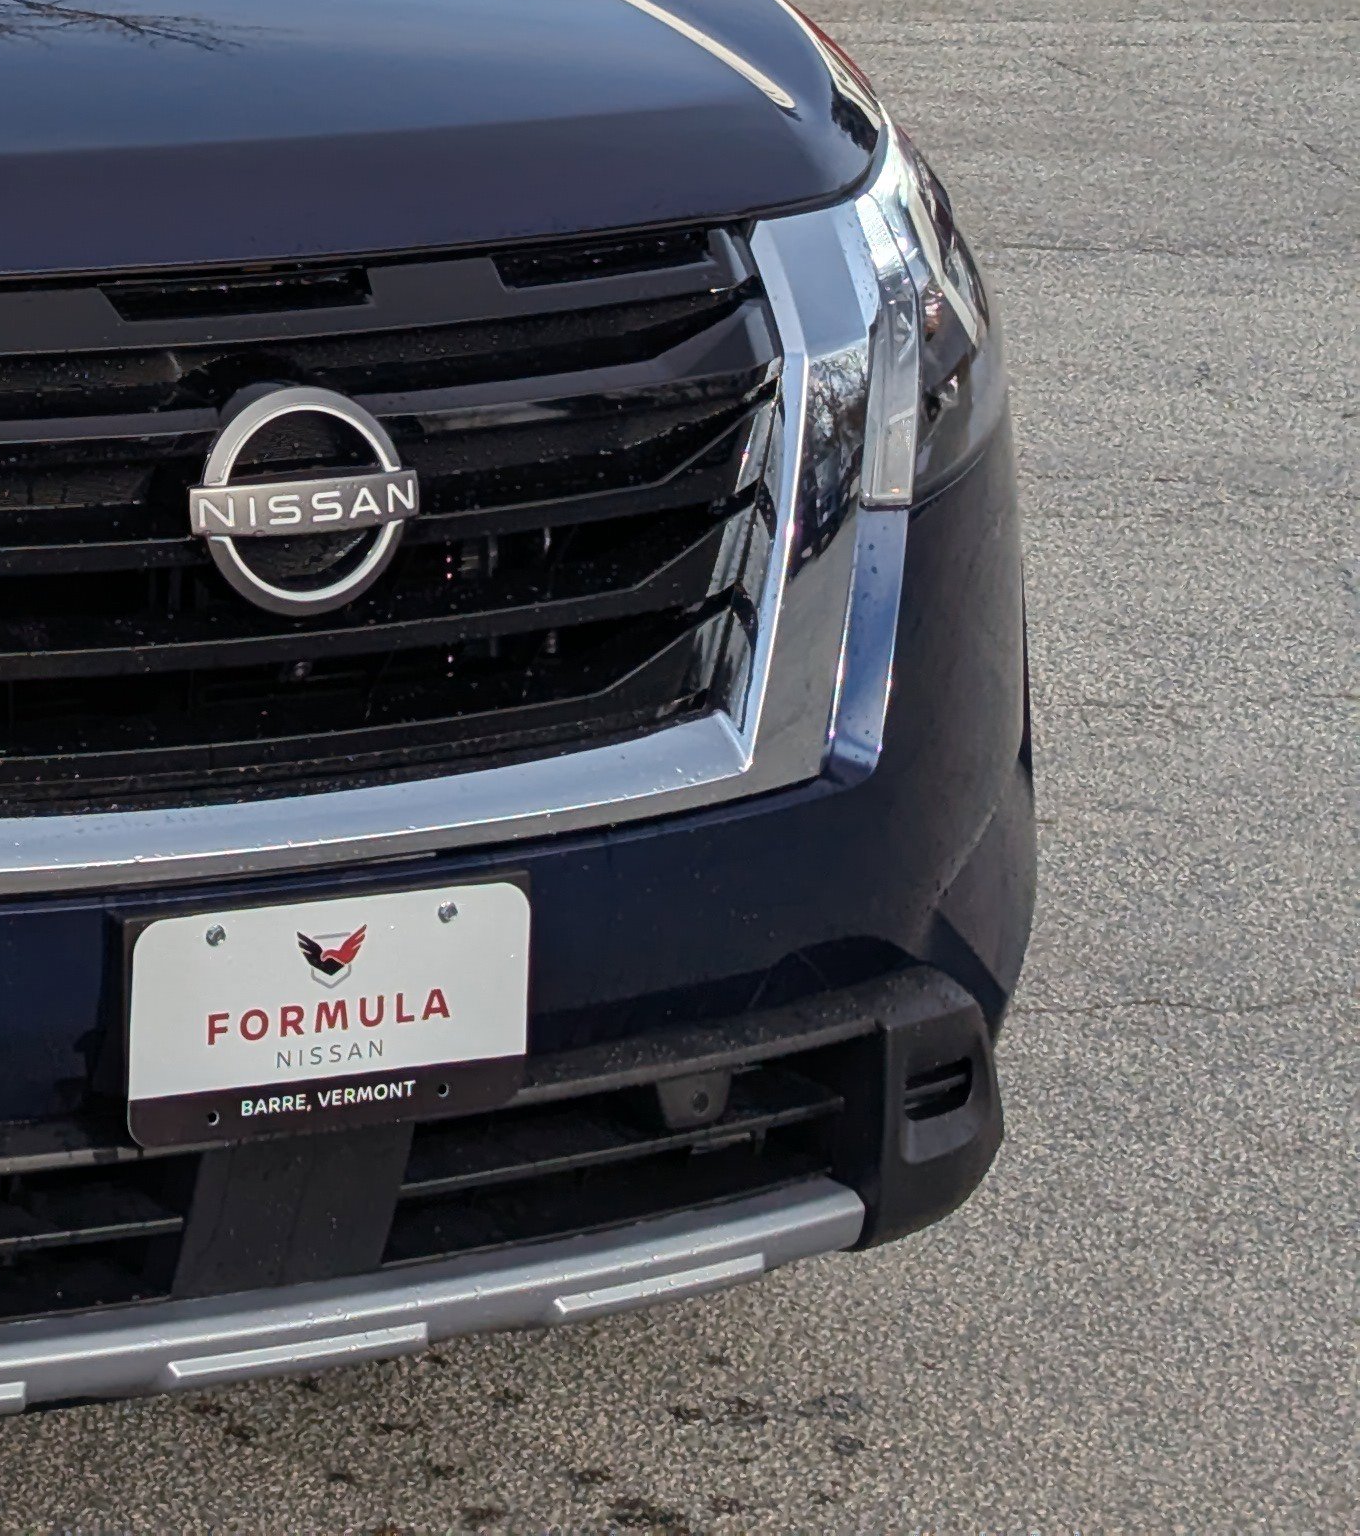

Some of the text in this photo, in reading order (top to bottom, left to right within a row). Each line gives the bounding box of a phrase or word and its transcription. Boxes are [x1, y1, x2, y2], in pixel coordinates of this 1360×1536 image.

[197, 479, 416, 528] NISSAN
[206, 987, 451, 1046] FORMULA
[275, 1039, 385, 1070] NISSAN
[240, 1080, 417, 1117] BARRE, VERMONT
